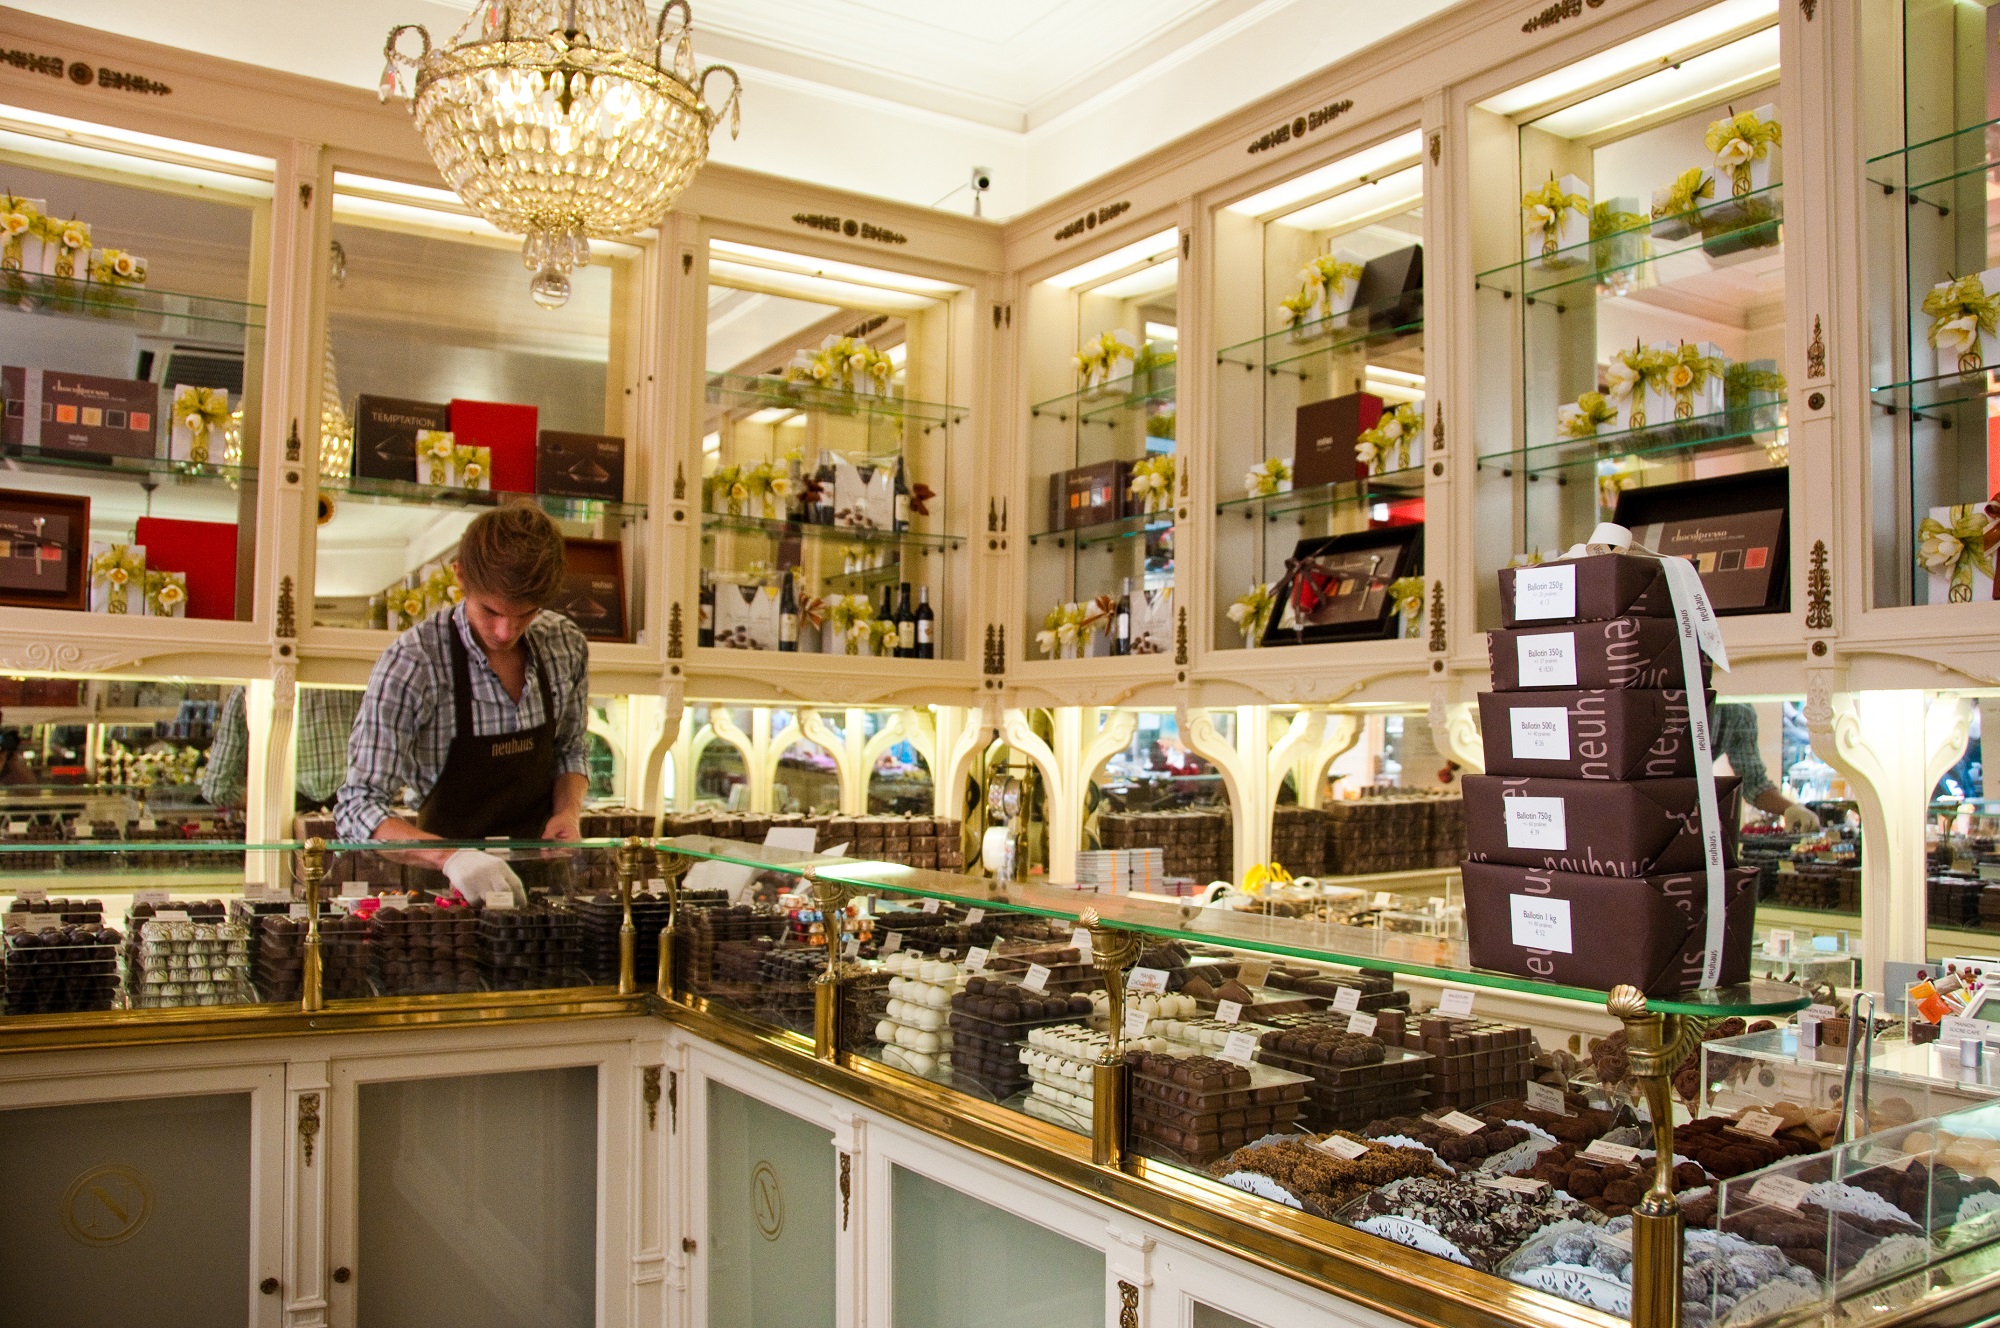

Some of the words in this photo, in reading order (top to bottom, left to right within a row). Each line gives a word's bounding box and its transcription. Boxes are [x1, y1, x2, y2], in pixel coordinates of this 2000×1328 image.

[371, 410, 437, 429] TEMPTATION
[1527, 582, 1548, 592] Ballotin
[1692, 593, 1711, 622] neuhaus
[1679, 609, 1693, 638] neuhaus
[1528, 649, 1548, 658] Ballotin
[1521, 721, 1541, 730] Ballotin
[1695, 721, 1707, 751] neuhaus
[491, 736, 535, 758] neuhaus
[1516, 811, 1537, 820] Ballotin
[1708, 835, 1719, 866] neuhaus
[1522, 909, 1544, 921] Ballotin
[1549, 913, 1557, 924] kg
[1707, 949, 1718, 979] neuhaus
[1954, 1021, 1976, 1029] MANON
